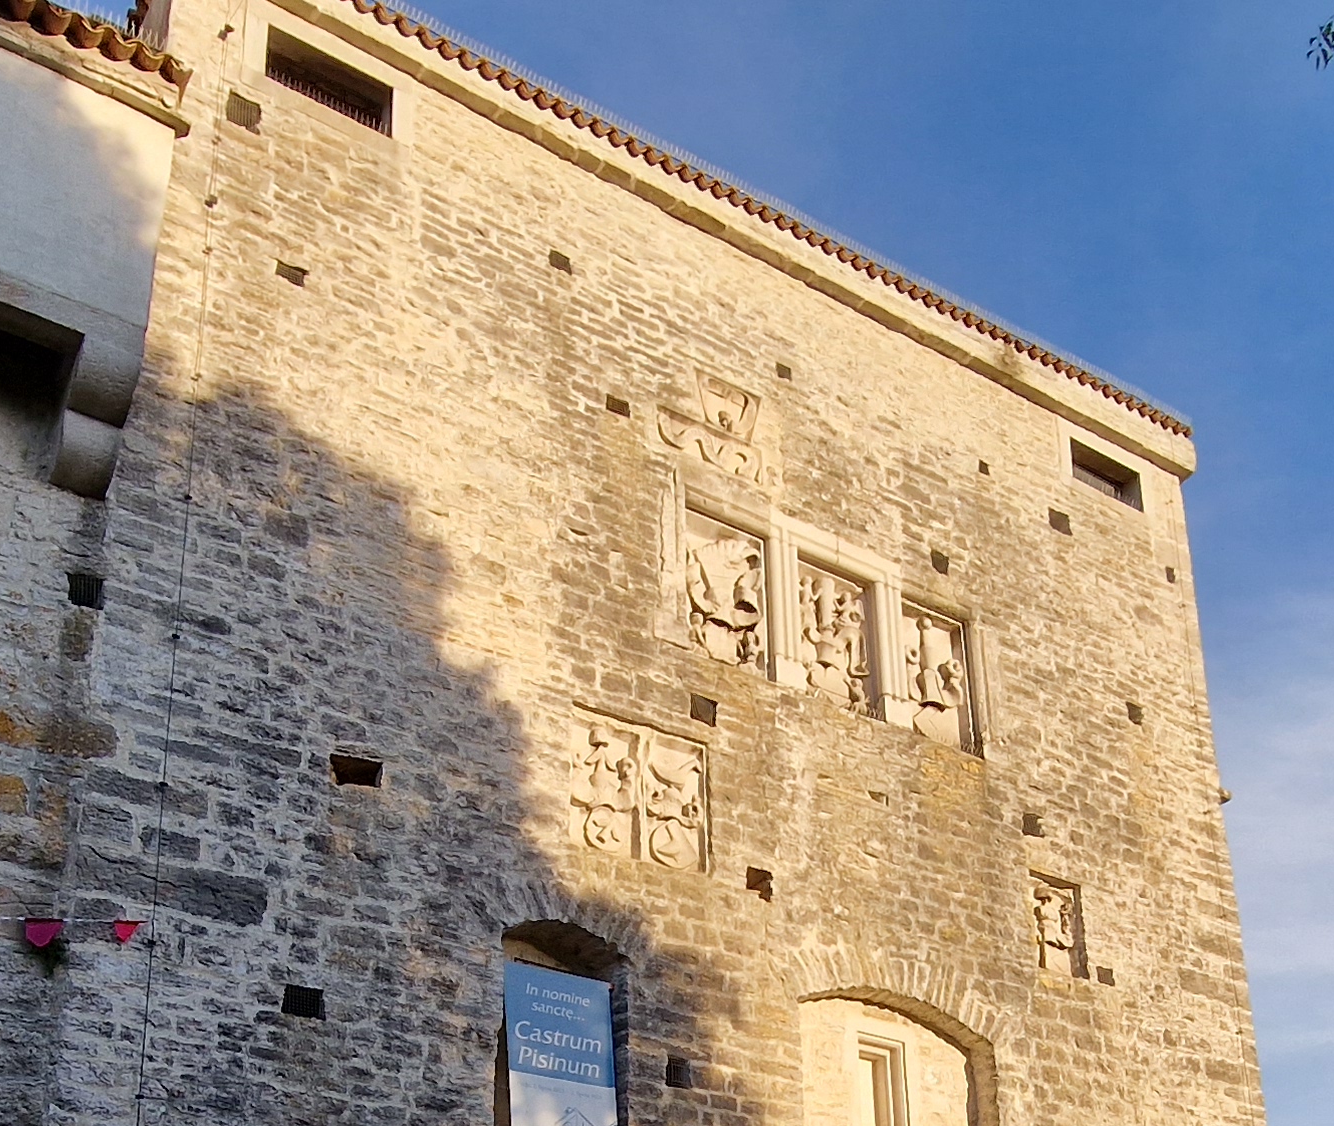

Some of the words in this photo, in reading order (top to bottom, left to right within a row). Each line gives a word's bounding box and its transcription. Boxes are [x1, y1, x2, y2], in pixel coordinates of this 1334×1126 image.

[525, 982, 538, 996] In
[541, 989, 591, 1007] nomine
[514, 1020, 602, 1054] Castrum
[517, 1045, 601, 1079] Pisinum
